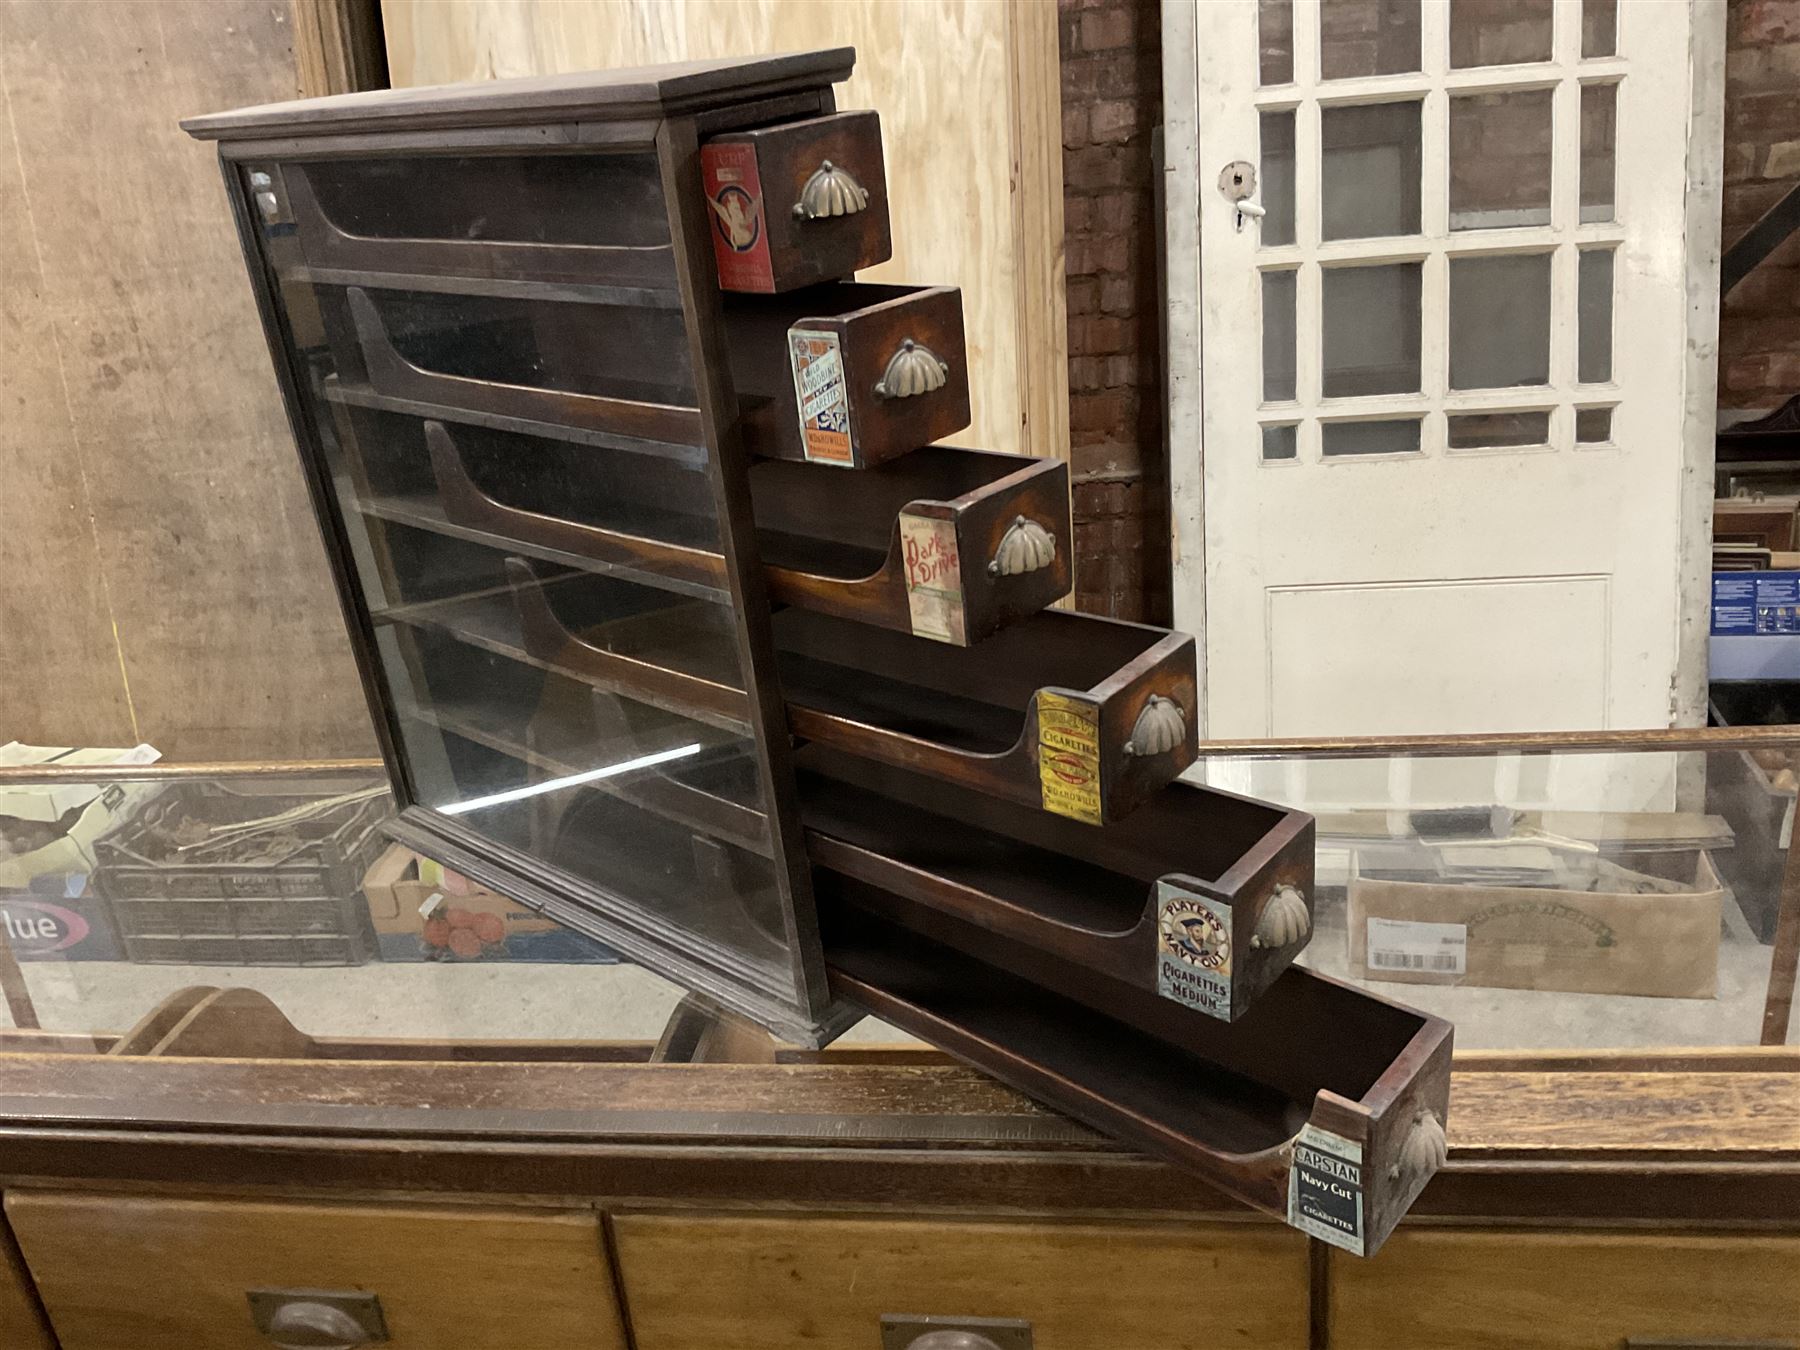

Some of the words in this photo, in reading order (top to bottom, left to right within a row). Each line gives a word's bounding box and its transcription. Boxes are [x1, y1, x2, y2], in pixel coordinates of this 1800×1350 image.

[802, 362, 836, 394] WOODBINE
[804, 388, 841, 417] CIGARETTES
[918, 552, 958, 583] Drive
[1043, 729, 1098, 755] CIGARETTES
[1164, 932, 1196, 965] NAVY
[1201, 951, 1224, 968] CUT
[1163, 961, 1227, 997] CIGARETTES
[1172, 981, 1217, 1010] MEDIUM
[1295, 1147, 1358, 1183] CAPSTAN
[1301, 1170, 1329, 1192] Navy
[1330, 1183, 1352, 1200] Cut
[1303, 1204, 1354, 1231] CIGARETTES
